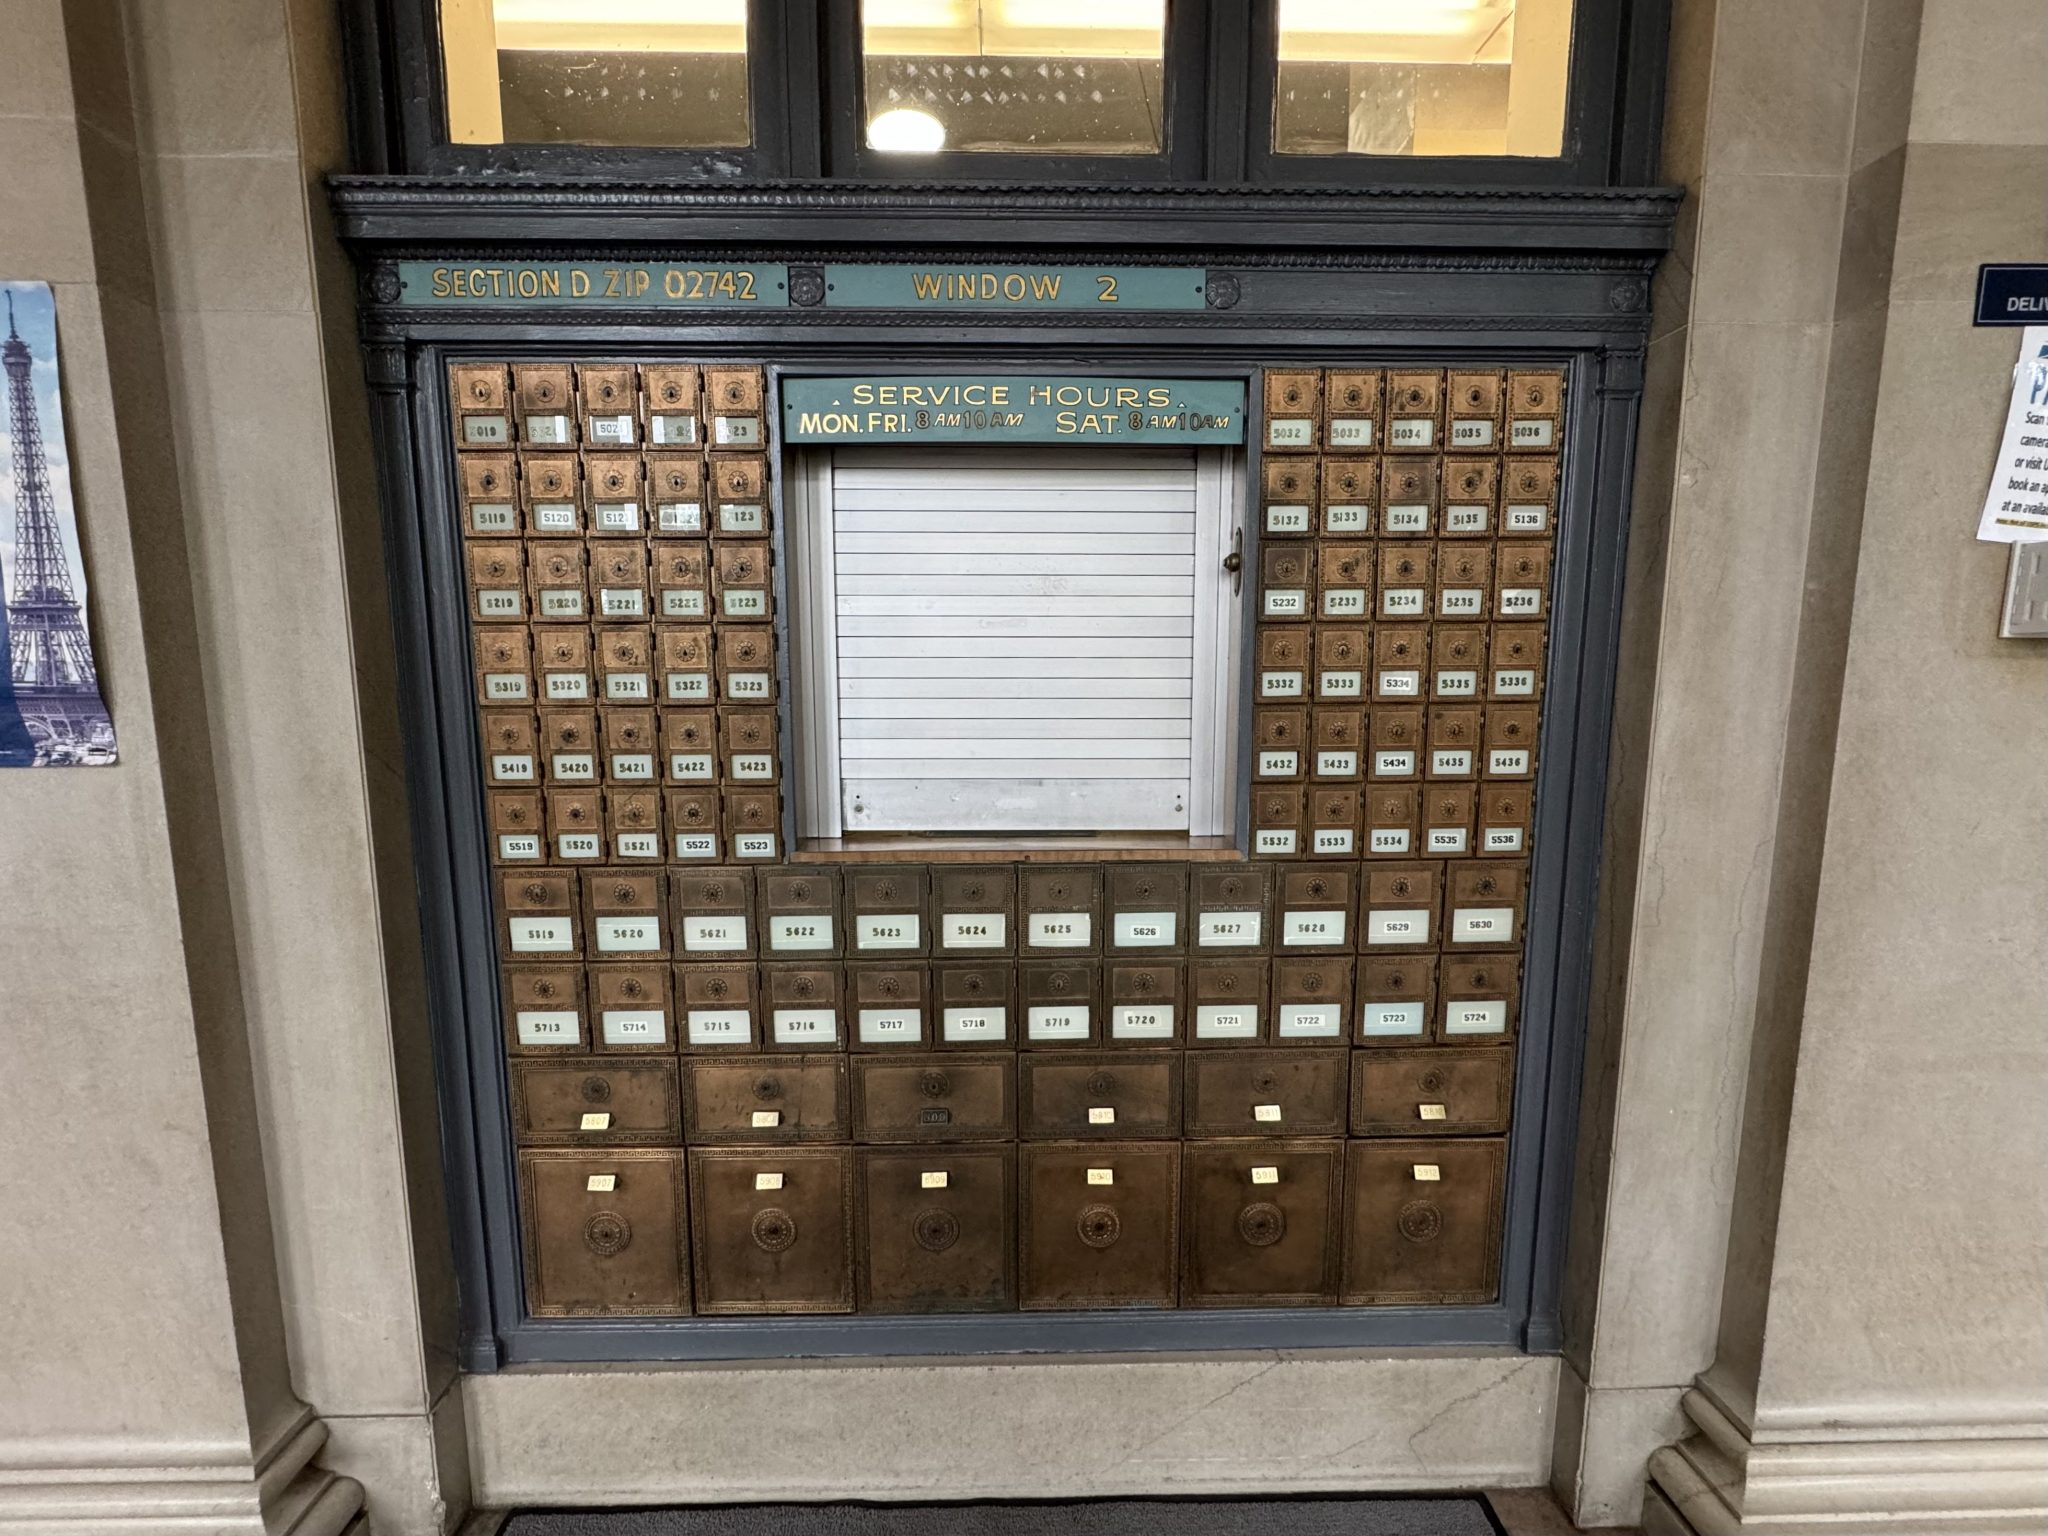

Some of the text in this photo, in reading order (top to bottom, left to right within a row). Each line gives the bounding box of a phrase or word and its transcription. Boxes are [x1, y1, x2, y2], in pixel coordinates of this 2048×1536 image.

[432, 268, 758, 300] SECTION D ZIP 02742
[913, 272, 1119, 301] WINDOW 2
[853, 384, 1171, 407] SERVICE HOURS
[915, 410, 930, 429] 8
[934, 413, 961, 427] AM
[963, 410, 986, 429] 10
[990, 413, 1024, 427] AM
[1129, 411, 1143, 430] 8
[1146, 415, 1177, 429] AM
[2025, 411, 2044, 425] Scan
[1273, 428, 1300, 438] 5032
[1332, 428, 1360, 438] 5033
[1393, 429, 1421, 439] 5034
[1454, 428, 1481, 438] 5035
[1514, 427, 1540, 437] 5036
[2015, 458, 2024, 468] or
[479, 513, 506, 524] 5119
[544, 513, 569, 522] 5120
[1273, 515, 1300, 525] 5132
[1332, 512, 1358, 523] 5133
[1393, 514, 1419, 524] 5134
[1453, 514, 1478, 525] 5135
[1514, 515, 1538, 524] 5136
[487, 598, 513, 608] 5219
[609, 600, 635, 609] 5221
[1272, 598, 1296, 607] 5232
[1330, 597, 1357, 607] 5233
[1389, 596, 1417, 606] 5234
[1505, 597, 1533, 607] 5236
[552, 680, 581, 690] 5320
[675, 680, 702, 690] 5322
[735, 681, 762, 691] 5323
[1267, 680, 1294, 689] 5332
[1327, 679, 1354, 688] 5333
[1386, 679, 1410, 687] 5334
[1441, 679, 1470, 689] 5335
[1500, 677, 1527, 686] 5336
[615, 682, 640, 691] 5321
[740, 762, 766, 771] 5423
[1266, 759, 1293, 769] 5432
[1324, 759, 1349, 769] 5433
[1383, 758, 1406, 767] 5434
[1438, 758, 1464, 766] 5435
[502, 763, 528, 773] 5419
[561, 763, 588, 773] 5420
[619, 763, 645, 773] 5421
[677, 762, 705, 772] 5422
[1262, 836, 1289, 846] 5532
[1320, 837, 1345, 846] 5533
[1376, 836, 1402, 846] 5534
[1434, 835, 1457, 844] 5535
[1491, 835, 1514, 844] 5536
[509, 842, 533, 850] 5519
[566, 840, 593, 849] 5520
[624, 842, 650, 851] 5521
[686, 841, 710, 849] 5522
[1044, 924, 1071, 934] 5625
[1213, 924, 1241, 933] 5627
[1386, 923, 1409, 932] 5629
[1470, 921, 1492, 929] 5630
[613, 929, 644, 938] 5620
[700, 929, 727, 938] 5621
[786, 927, 815, 936] 5622
[872, 927, 901, 937] 5623
[958, 926, 987, 935] 5624
[1128, 1015, 1155, 1024] 5720
[1217, 1017, 1238, 1025] 5721
[1297, 1017, 1319, 1025] 5722
[1383, 1014, 1405, 1022] 5723
[1464, 1013, 1486, 1022] 5724
[623, 1023, 646, 1031] 5714
[704, 1022, 730, 1031] 5715
[789, 1022, 815, 1031] 5716
[880, 1021, 903, 1029] 5717
[962, 1019, 985, 1028] 5718
[1045, 1018, 1070, 1027] 5719
[534, 1023, 560, 1032] 5713
